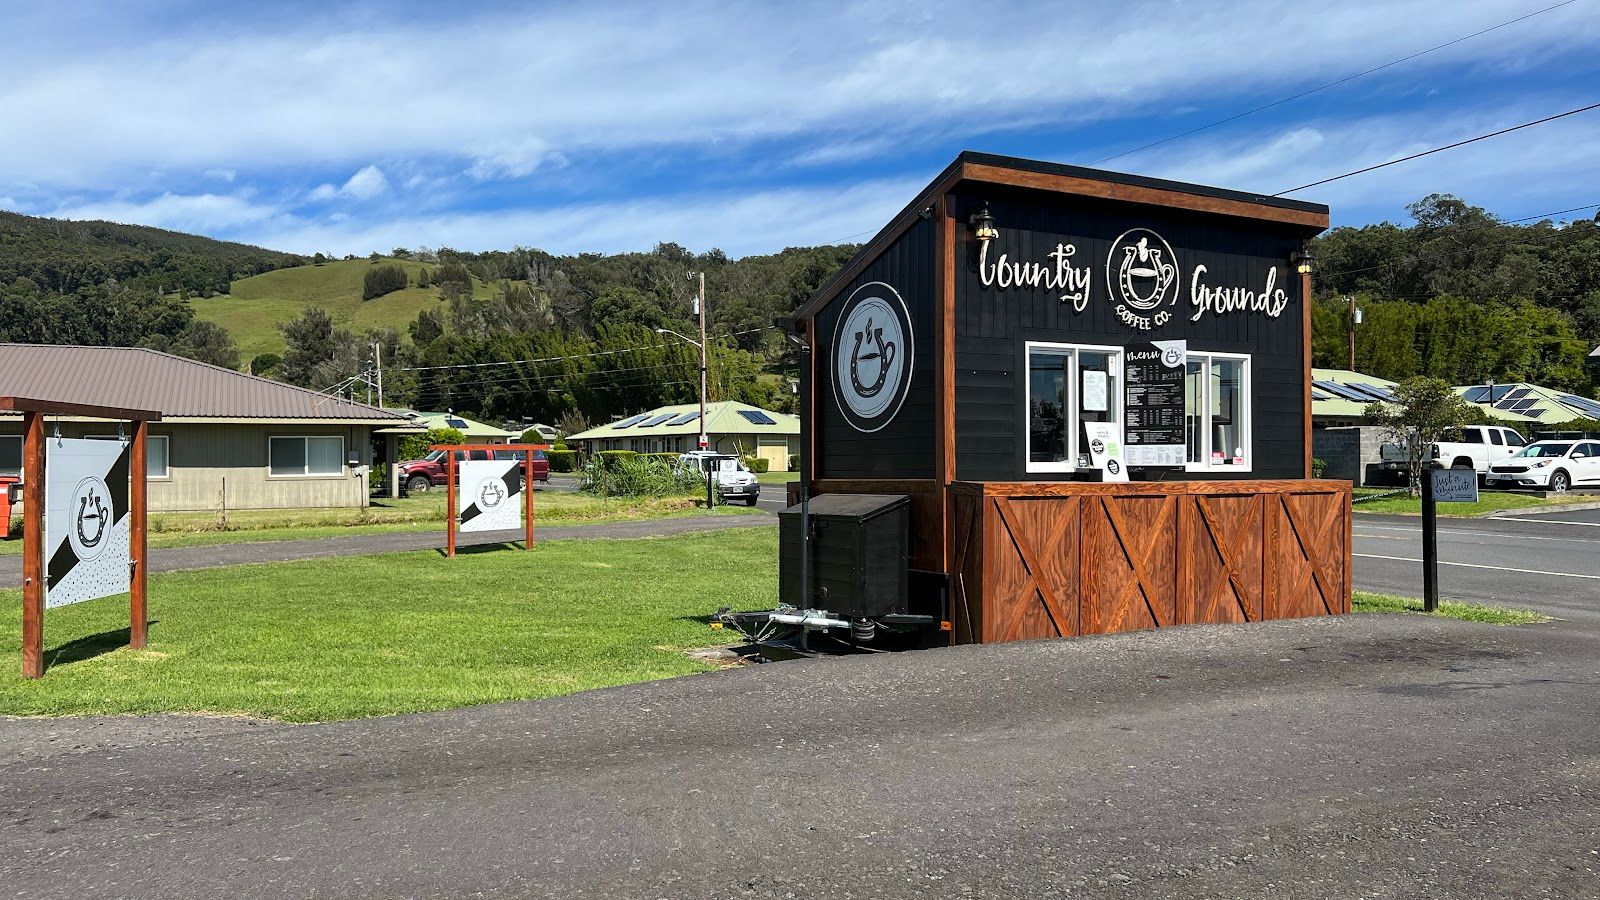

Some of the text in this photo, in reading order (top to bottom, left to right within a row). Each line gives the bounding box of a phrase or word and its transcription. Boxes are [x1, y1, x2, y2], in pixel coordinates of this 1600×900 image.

[979, 229, 1288, 321] Country Grounds
[1114, 304, 1151, 330] COFFEE
[1126, 351, 1160, 362] menu
[1434, 471, 1454, 488] Just
